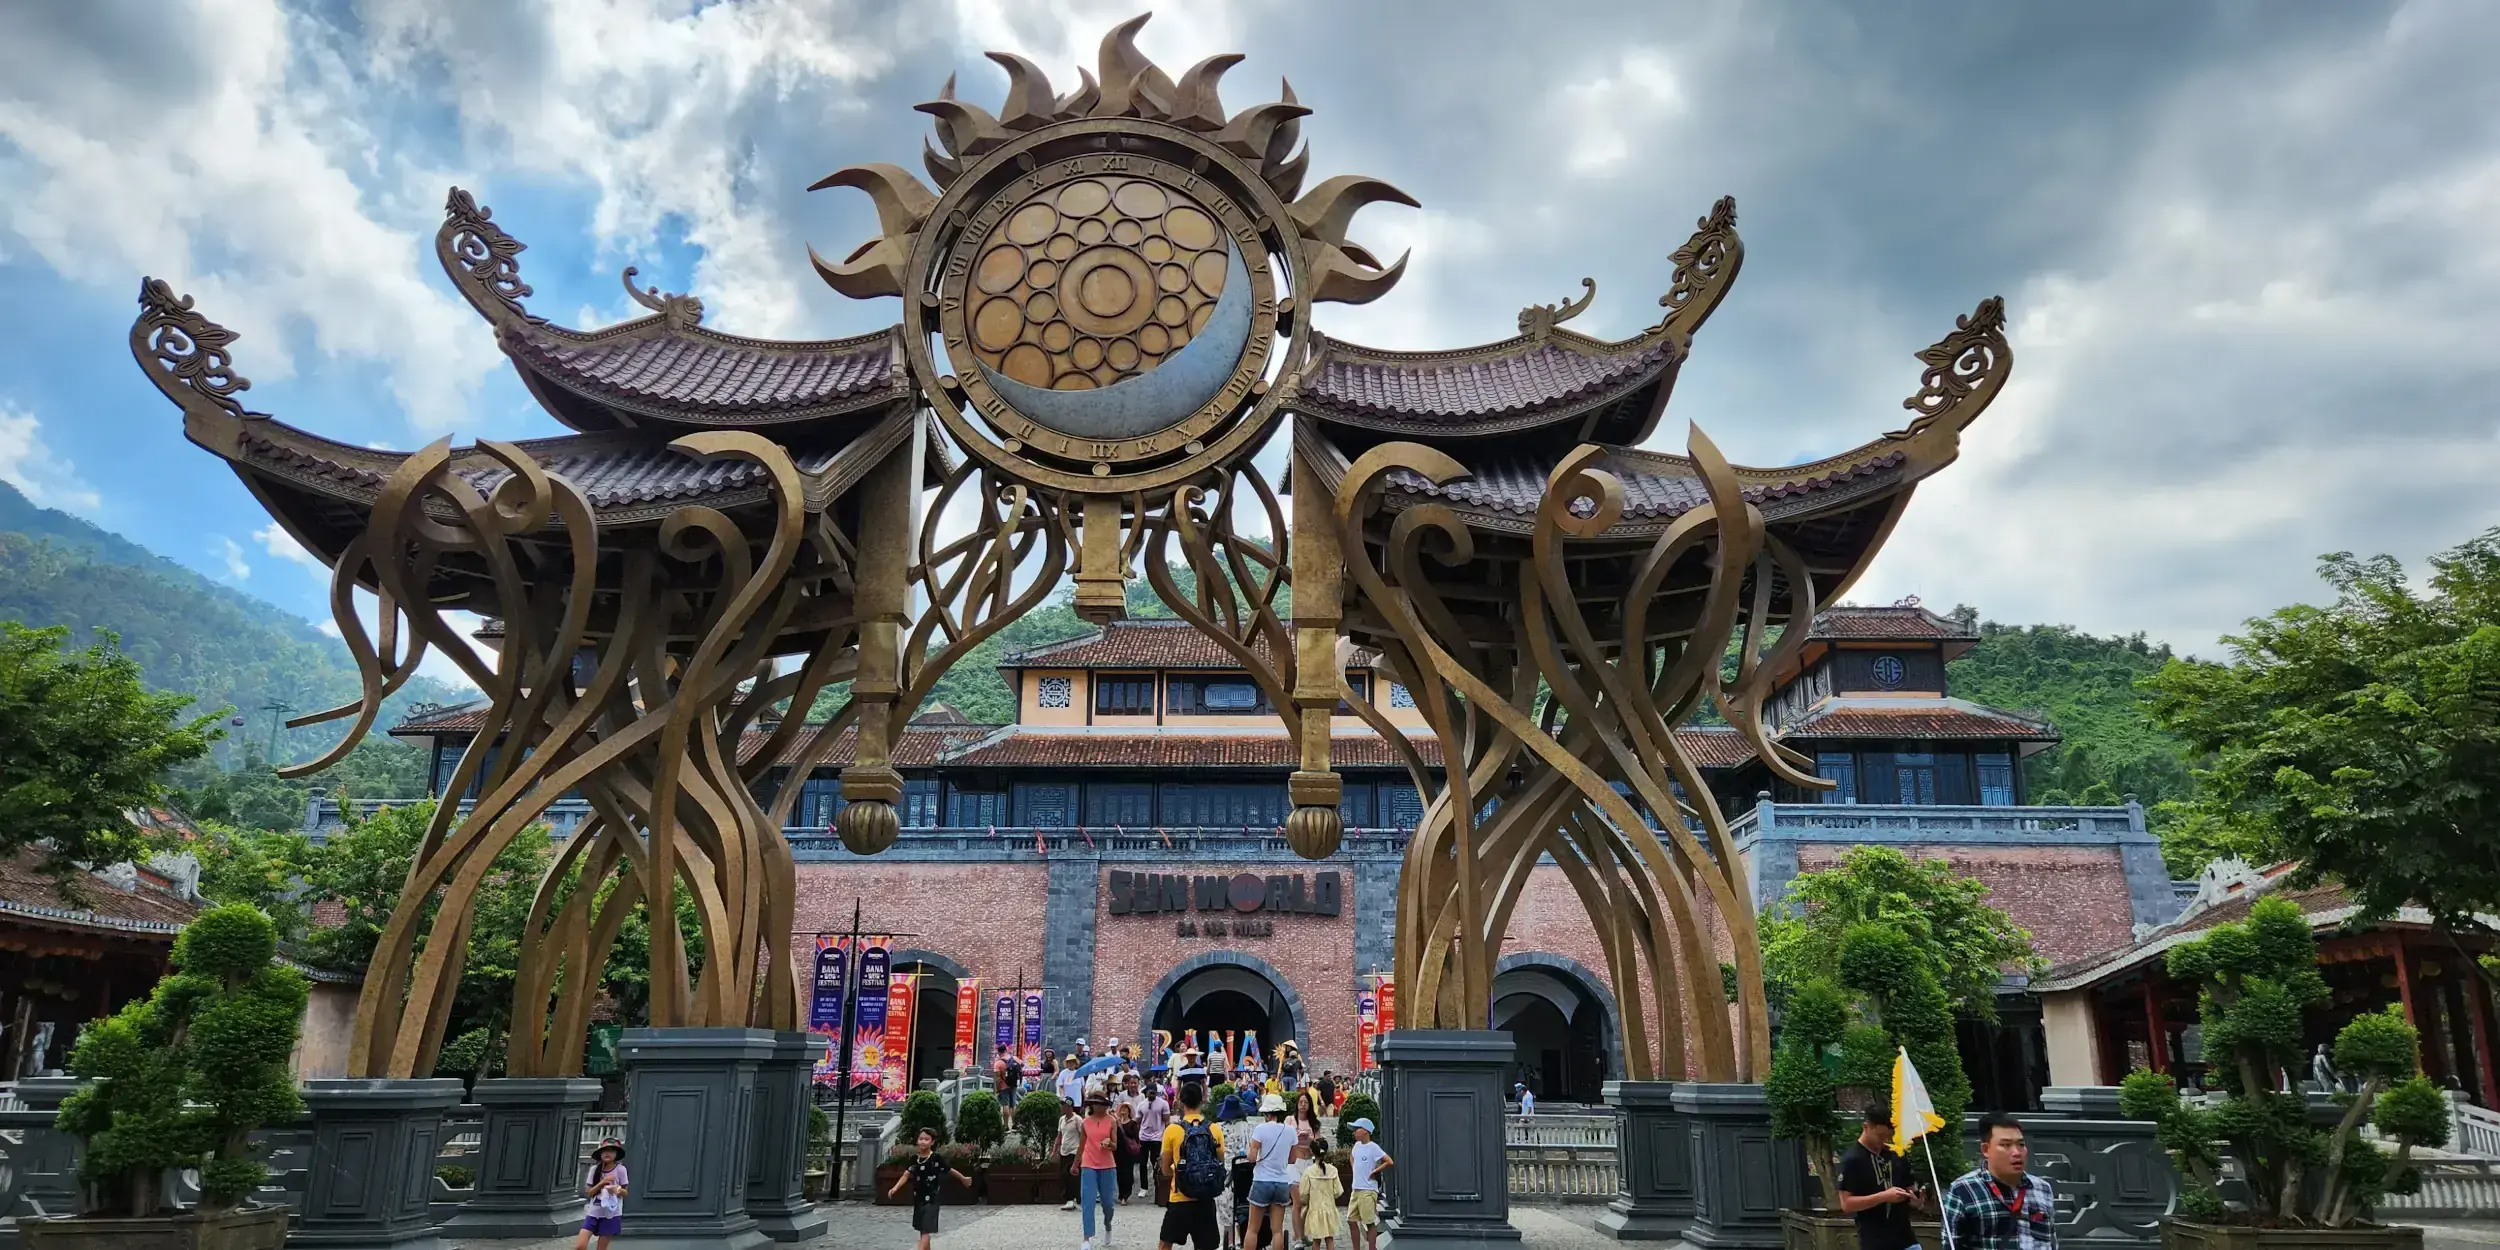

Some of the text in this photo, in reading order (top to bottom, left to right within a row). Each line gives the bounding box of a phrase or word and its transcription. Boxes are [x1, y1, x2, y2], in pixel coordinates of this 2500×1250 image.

[1110, 870, 1187, 914] SUN
[1178, 921, 1273, 937] BA NA HILLS
[821, 965, 840, 973] BANA
[865, 964, 884, 973] BANA
